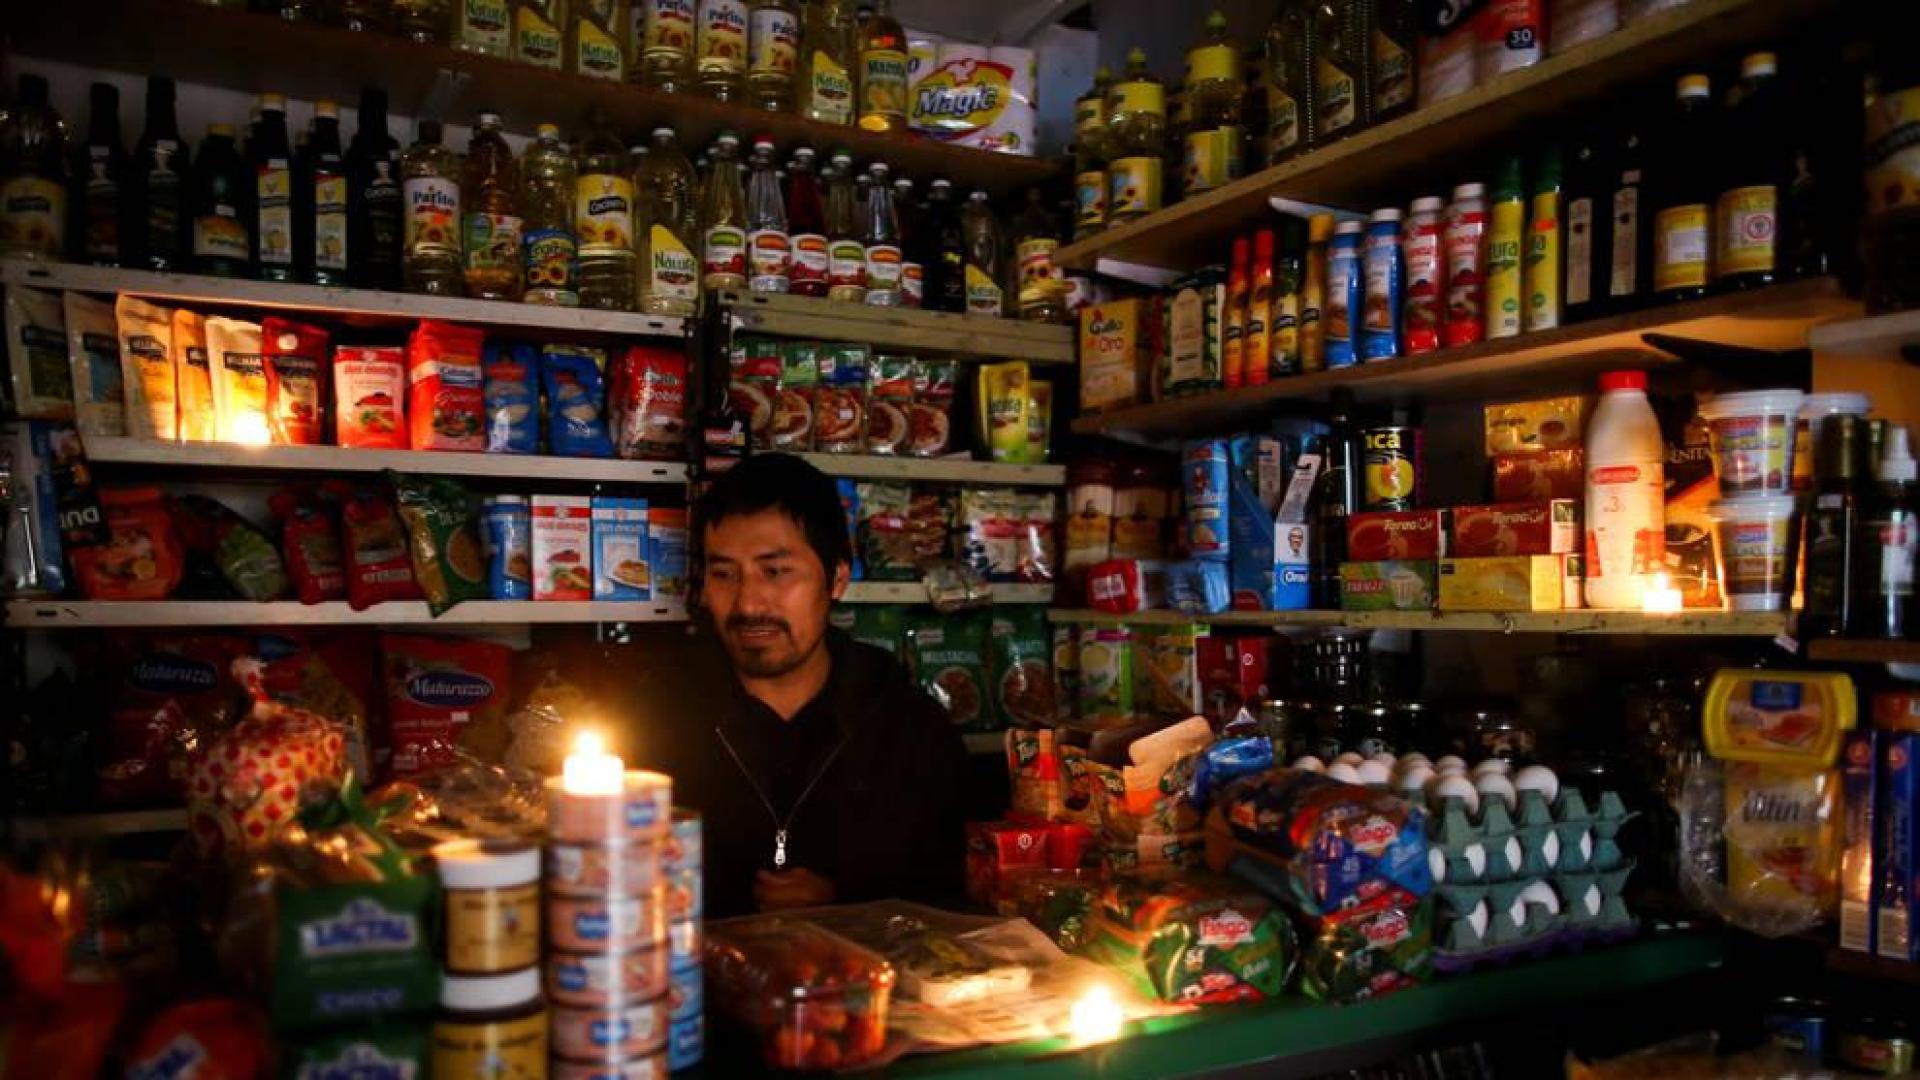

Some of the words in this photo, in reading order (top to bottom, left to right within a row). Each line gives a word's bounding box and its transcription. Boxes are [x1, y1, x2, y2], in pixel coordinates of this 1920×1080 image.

[1510, 28, 1532, 43] 30
[914, 83, 998, 117] Magic
[408, 680, 493, 698] Matarazzo
